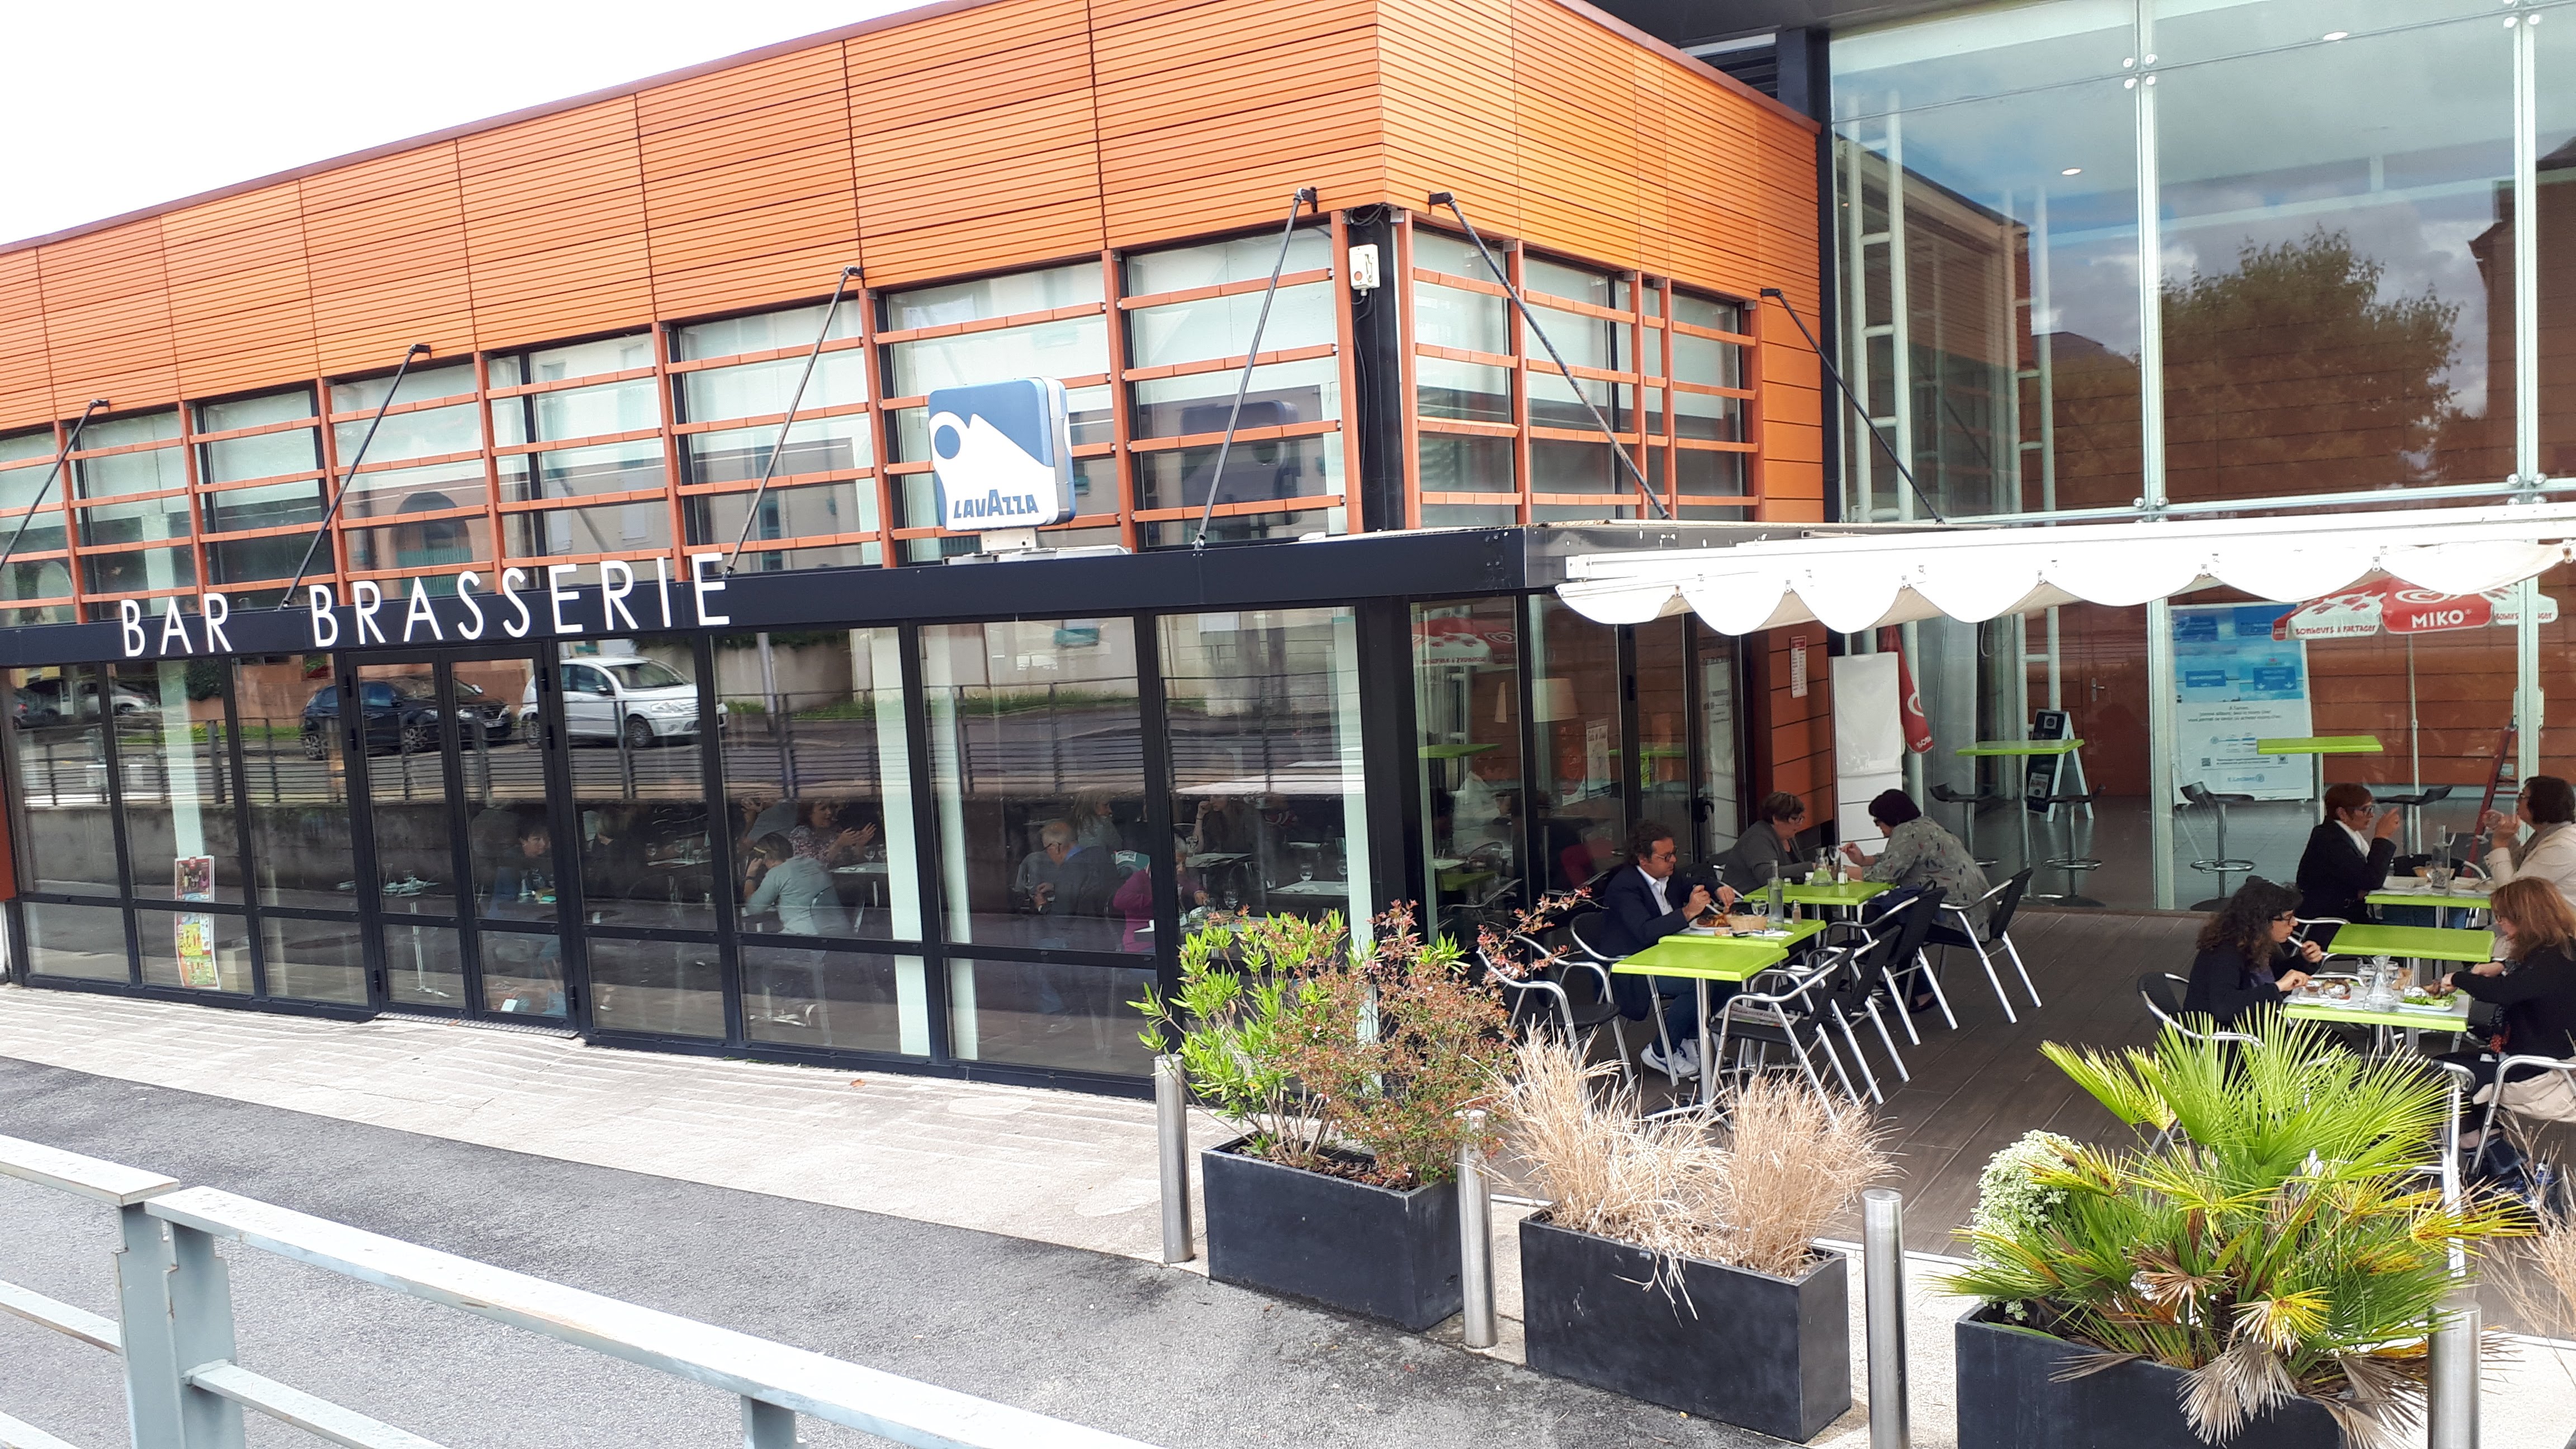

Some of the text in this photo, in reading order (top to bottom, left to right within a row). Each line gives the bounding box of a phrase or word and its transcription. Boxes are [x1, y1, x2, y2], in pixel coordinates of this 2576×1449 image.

[953, 489, 1039, 519] LAVAZZA
[120, 552, 730, 657] BAR BRASSERIE
[2411, 609, 2464, 628] MIKO
